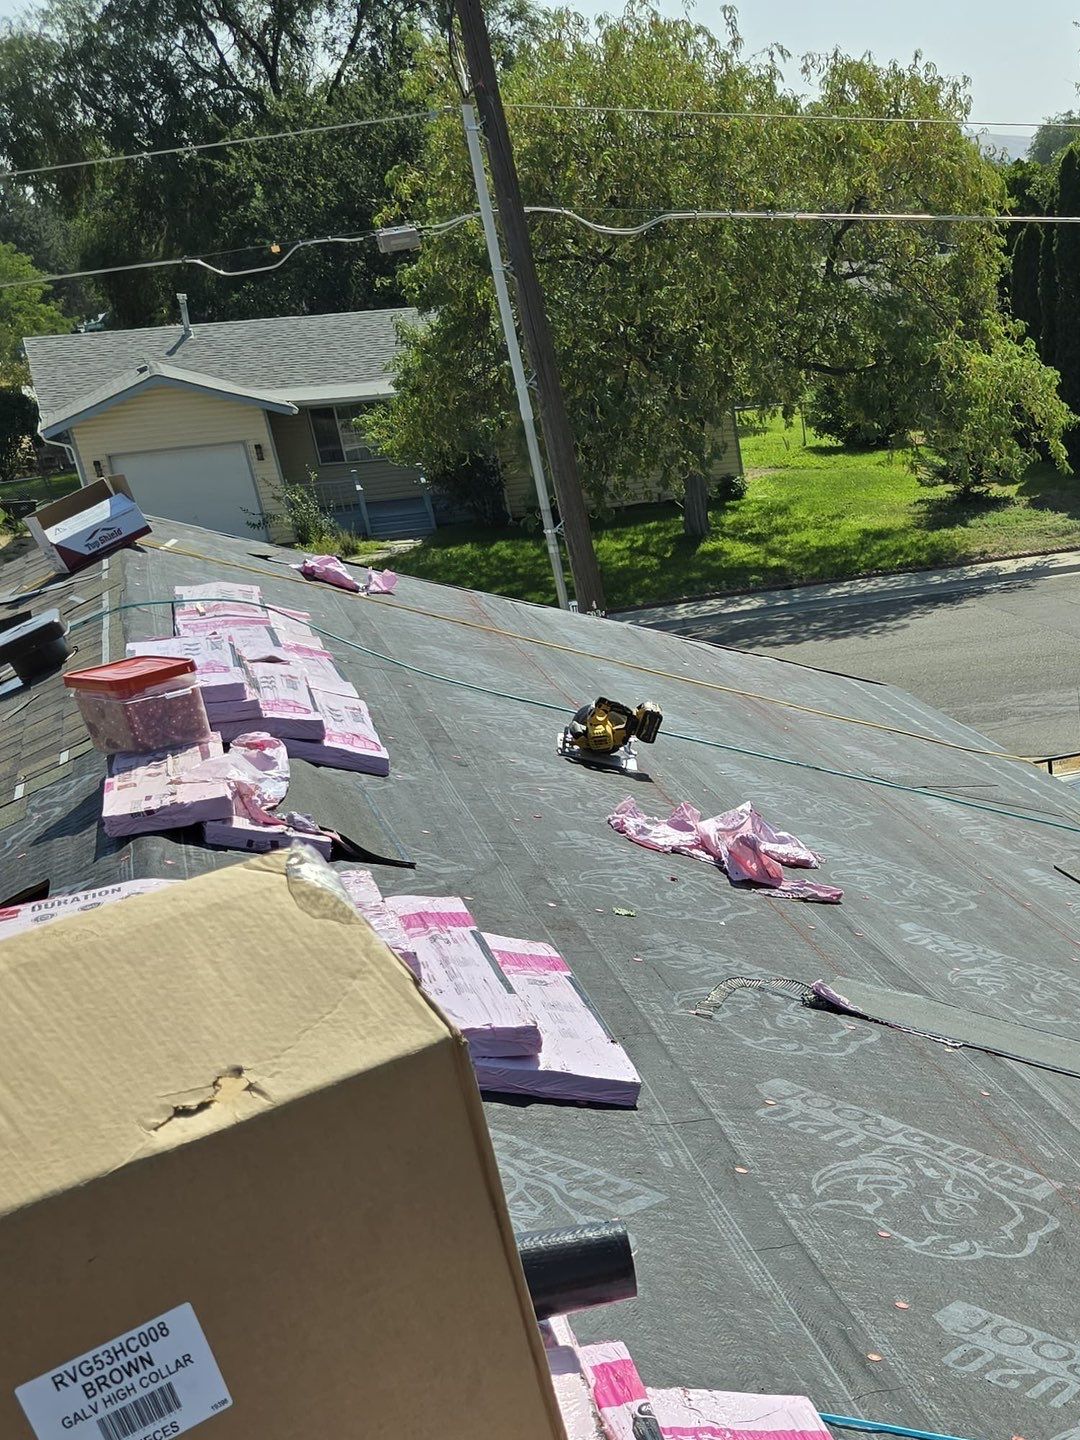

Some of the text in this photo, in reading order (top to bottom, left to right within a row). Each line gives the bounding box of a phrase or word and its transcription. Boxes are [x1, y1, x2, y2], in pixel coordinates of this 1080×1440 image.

[84, 528, 123, 551] Top Shield
[31, 886, 122, 913] DURATION
[49, 1317, 171, 1394] RVG53HC008
[79, 1349, 156, 1400] BROWN
[59, 1400, 102, 1430] GALV
[100, 1381, 138, 1409] HIGH
[137, 1351, 195, 1390] COLLAR
